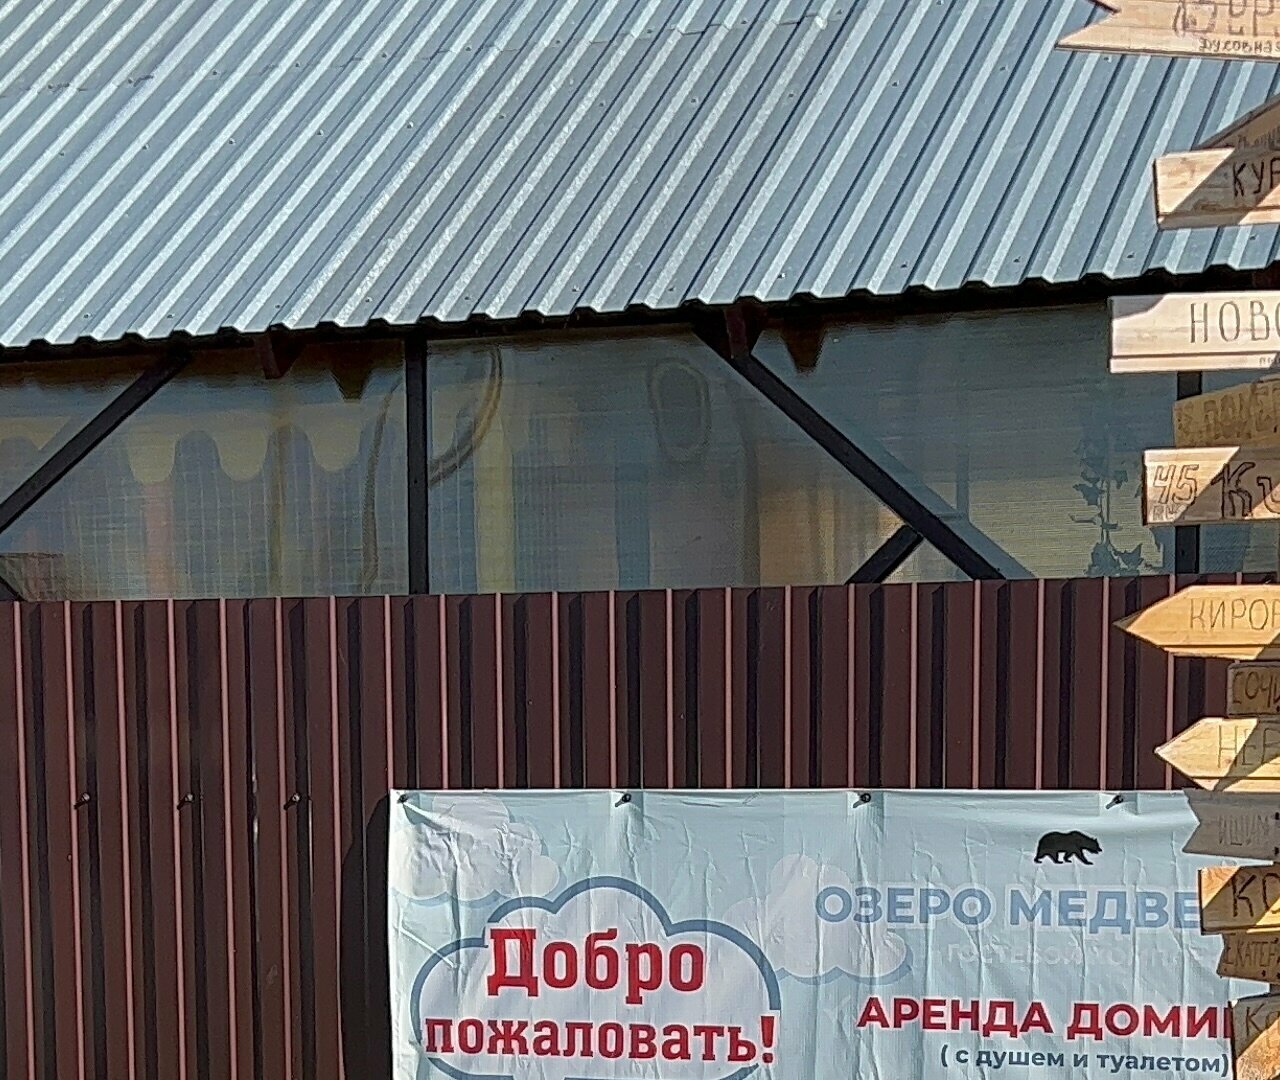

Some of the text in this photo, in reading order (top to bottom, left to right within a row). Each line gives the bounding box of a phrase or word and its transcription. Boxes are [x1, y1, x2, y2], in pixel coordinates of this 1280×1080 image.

[1152, 463, 1200, 505] 45
[816, 886, 1199, 935] ОЗЕРО МЕДВЕ
[486, 928, 705, 1005] Добро
[425, 1015, 776, 1064] пожаловать!
[858, 997, 1233, 1042] АРЕНДА ДОМИ
[975, 1049, 1065, 1070] душем
[1073, 1053, 1088, 1069] и
[1097, 1052, 1229, 1078] туалетом)
